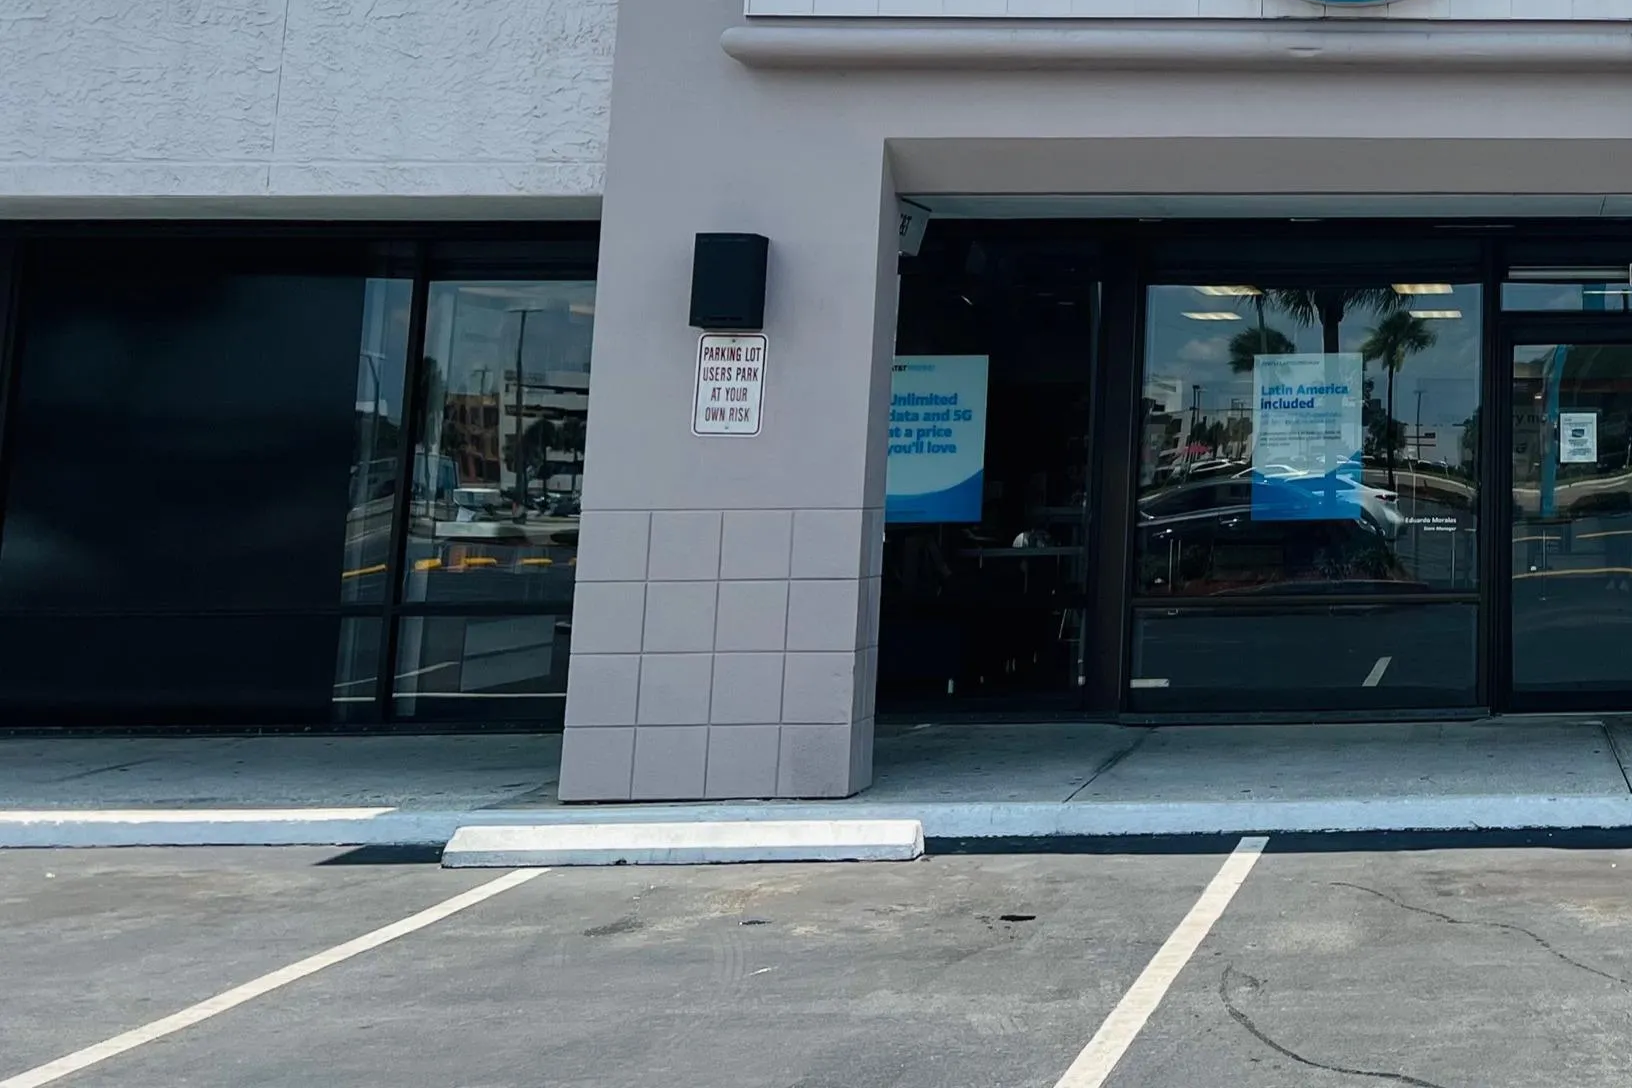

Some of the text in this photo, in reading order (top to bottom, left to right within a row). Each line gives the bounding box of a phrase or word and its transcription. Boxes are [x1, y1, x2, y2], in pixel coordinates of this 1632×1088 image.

[703, 346, 762, 362] PARKING LOT
[703, 367, 759, 382] USERS PARK
[710, 387, 748, 402] AT YOUR
[1261, 383, 1349, 396] Latin America
[1260, 397, 1315, 410] included
[704, 407, 750, 423] OWN RISK
[923, 409, 950, 422] and
[953, 409, 972, 421] 5G
[904, 428, 913, 438] a
[916, 425, 953, 441] price
[927, 441, 957, 454] love
